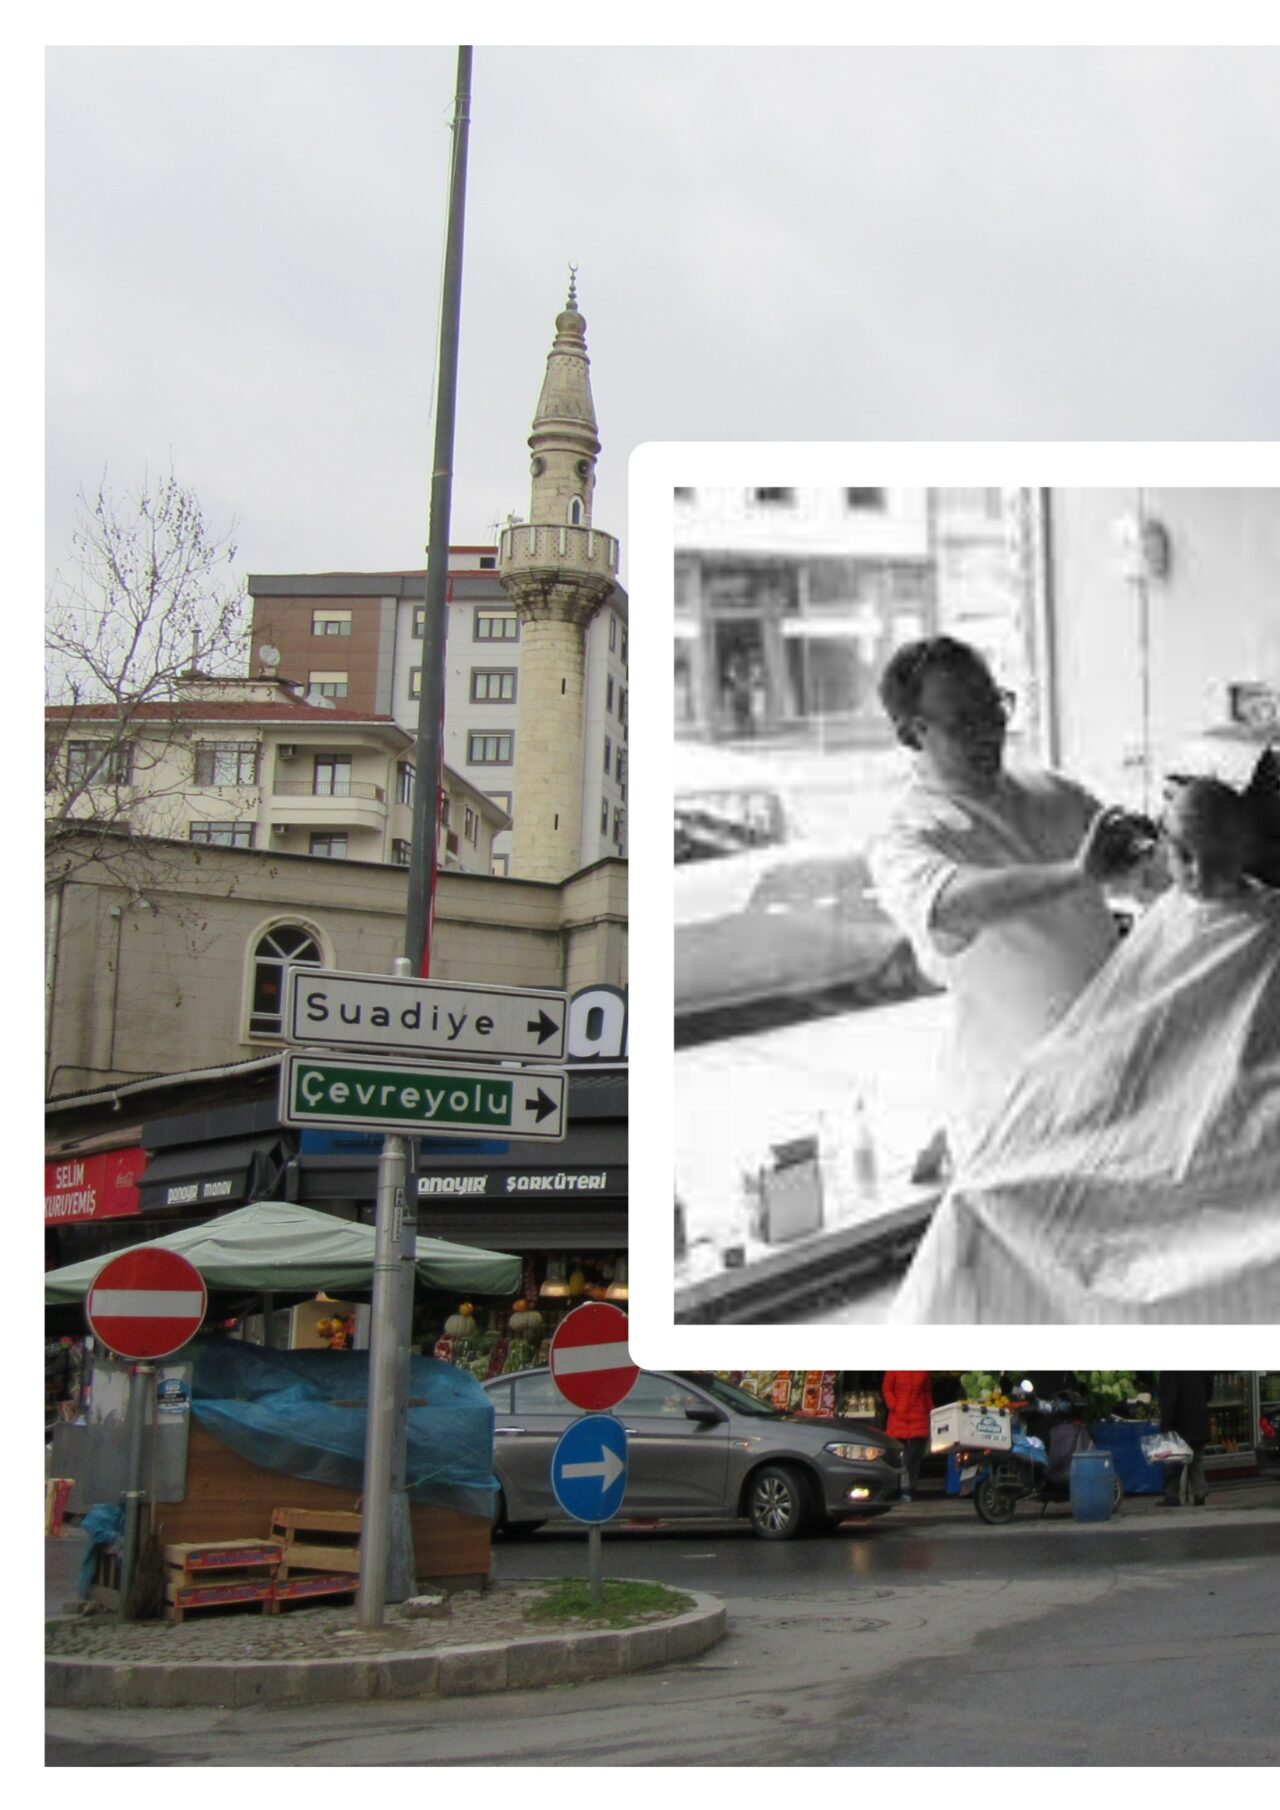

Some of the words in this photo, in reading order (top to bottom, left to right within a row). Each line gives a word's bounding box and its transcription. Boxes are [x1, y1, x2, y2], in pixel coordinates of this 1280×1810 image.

[306, 992, 495, 1041] Suadiye
[301, 1071, 508, 1118] Çevreyolu
[56, 1160, 85, 1189] SELİM
